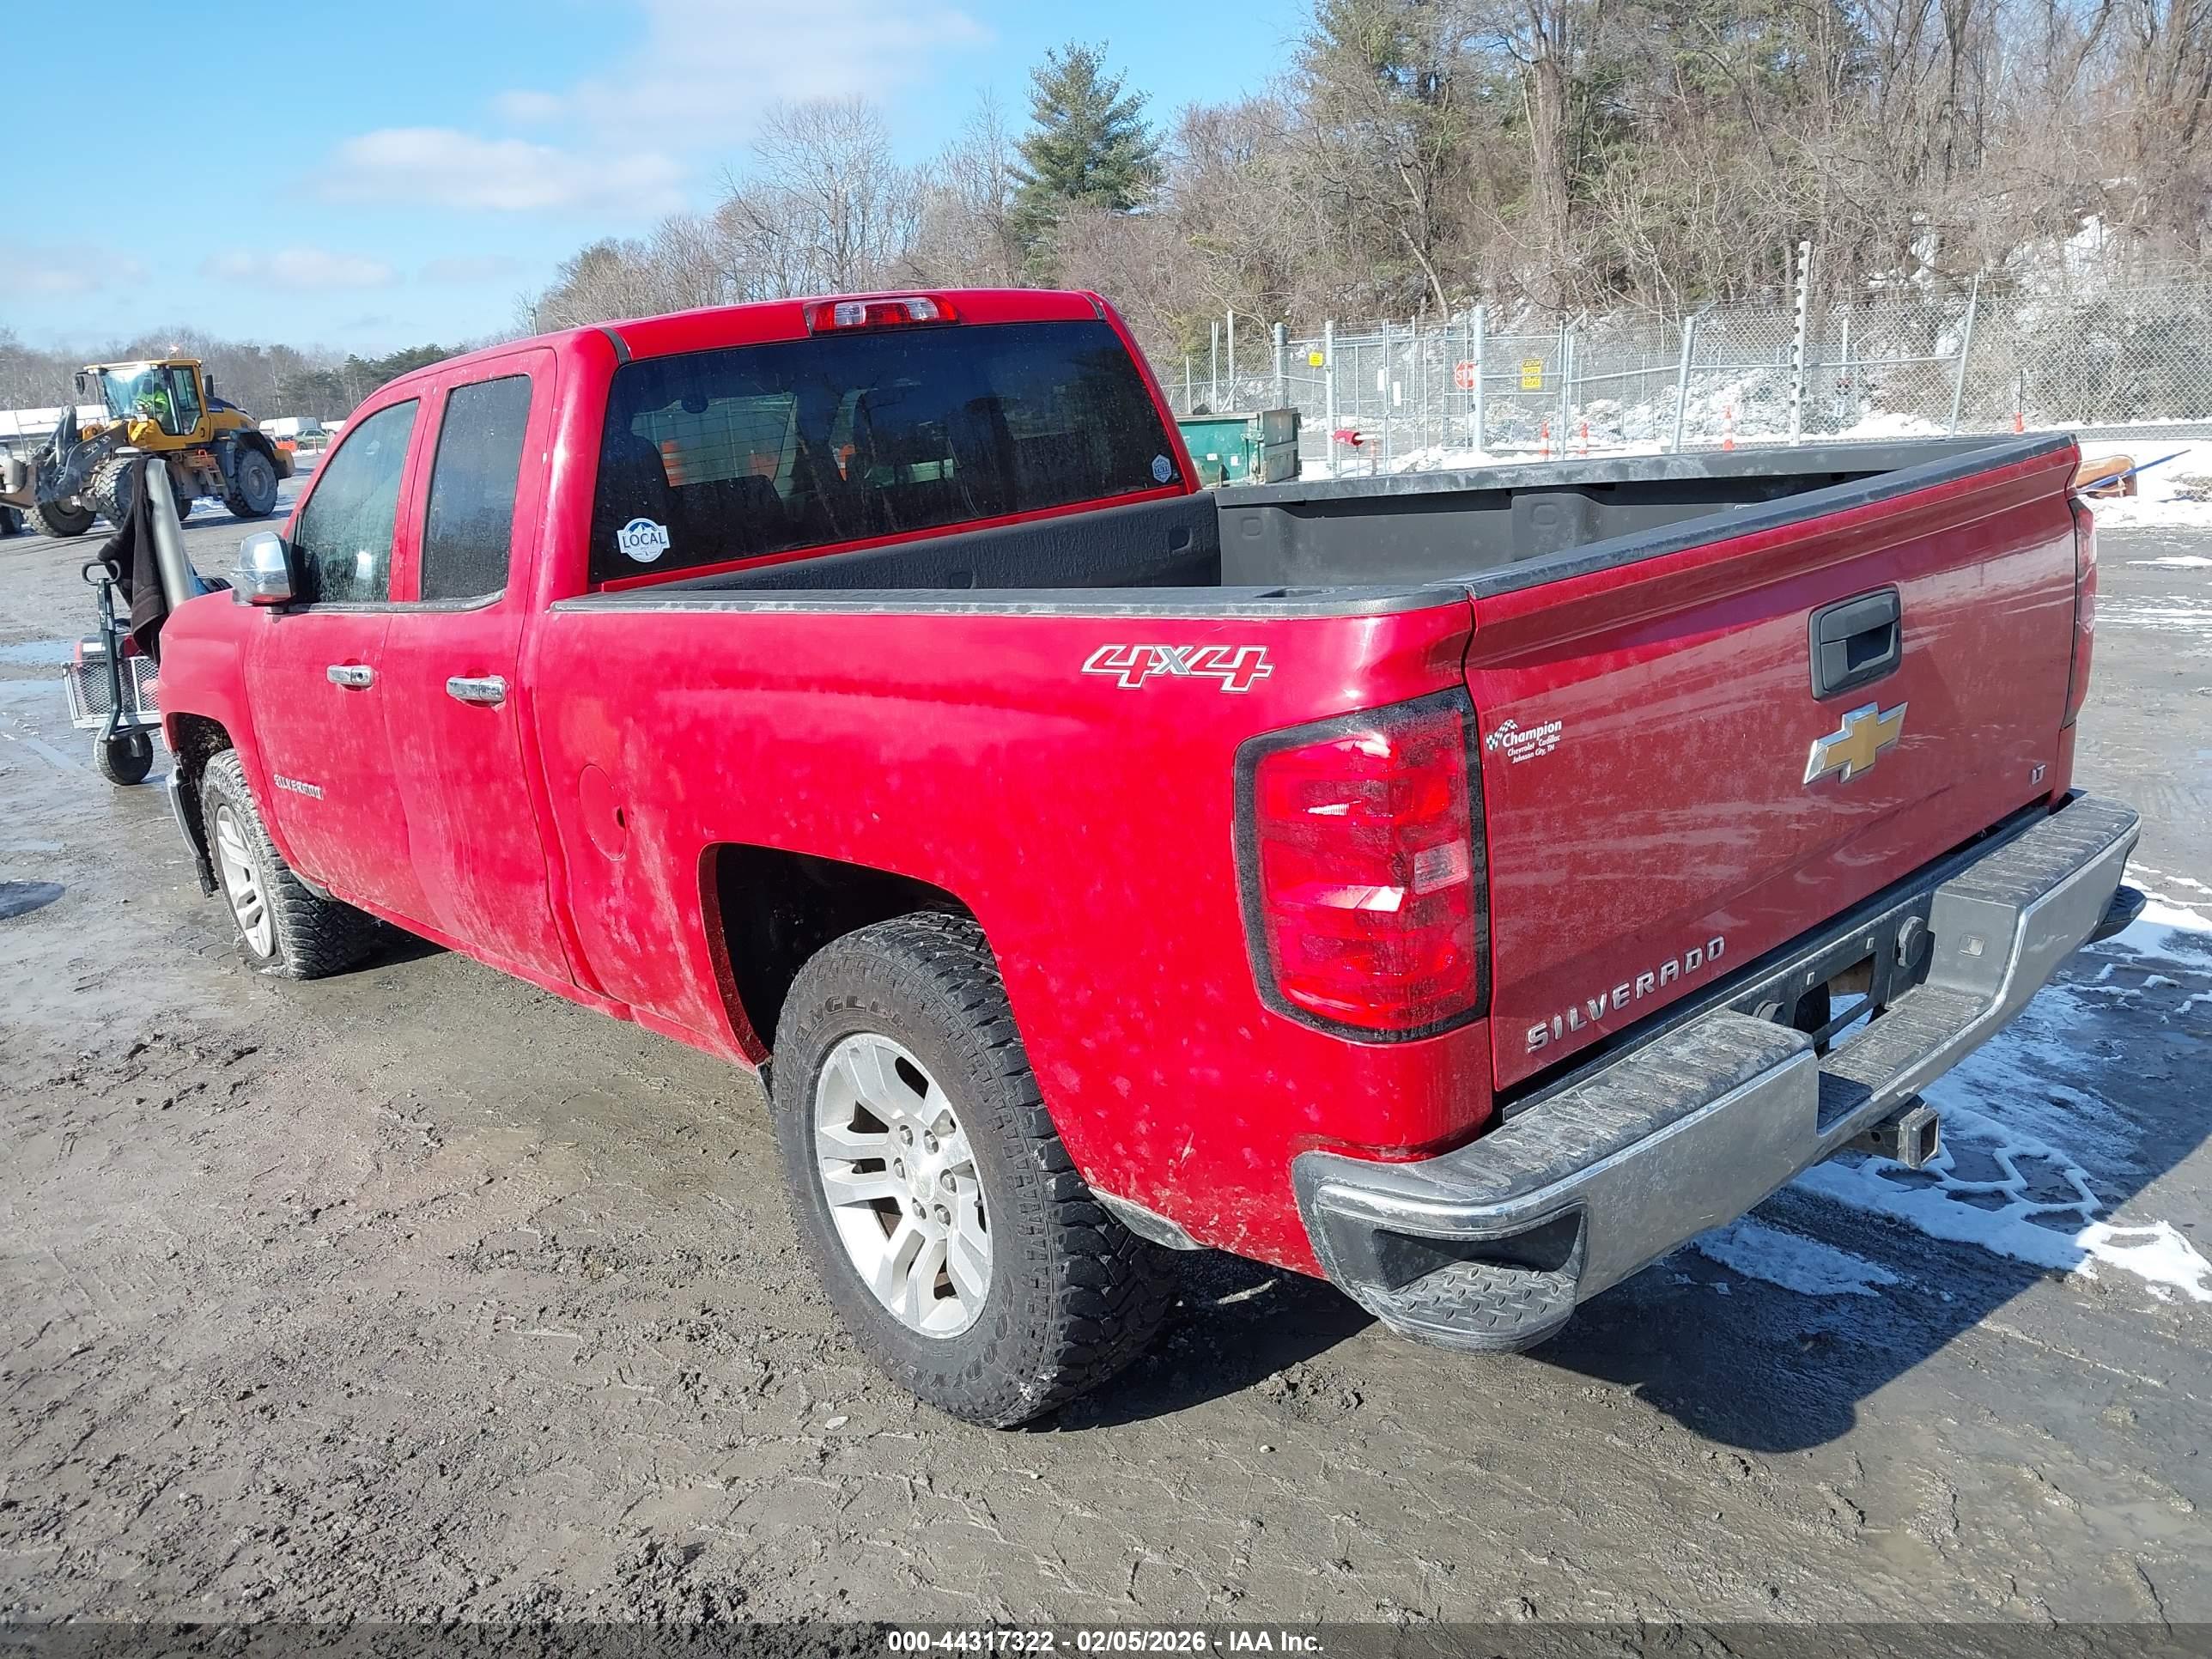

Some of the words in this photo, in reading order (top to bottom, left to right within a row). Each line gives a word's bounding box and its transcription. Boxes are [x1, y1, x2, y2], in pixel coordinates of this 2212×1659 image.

[622, 532, 666, 548] LOCAL
[1503, 720, 1561, 747] Champion
[1508, 742, 1534, 757] Chevrolet
[1539, 735, 1560, 746] Cadillac
[1512, 752, 1534, 763] Johnson
[1526, 934, 1725, 1054] SILVERADO
